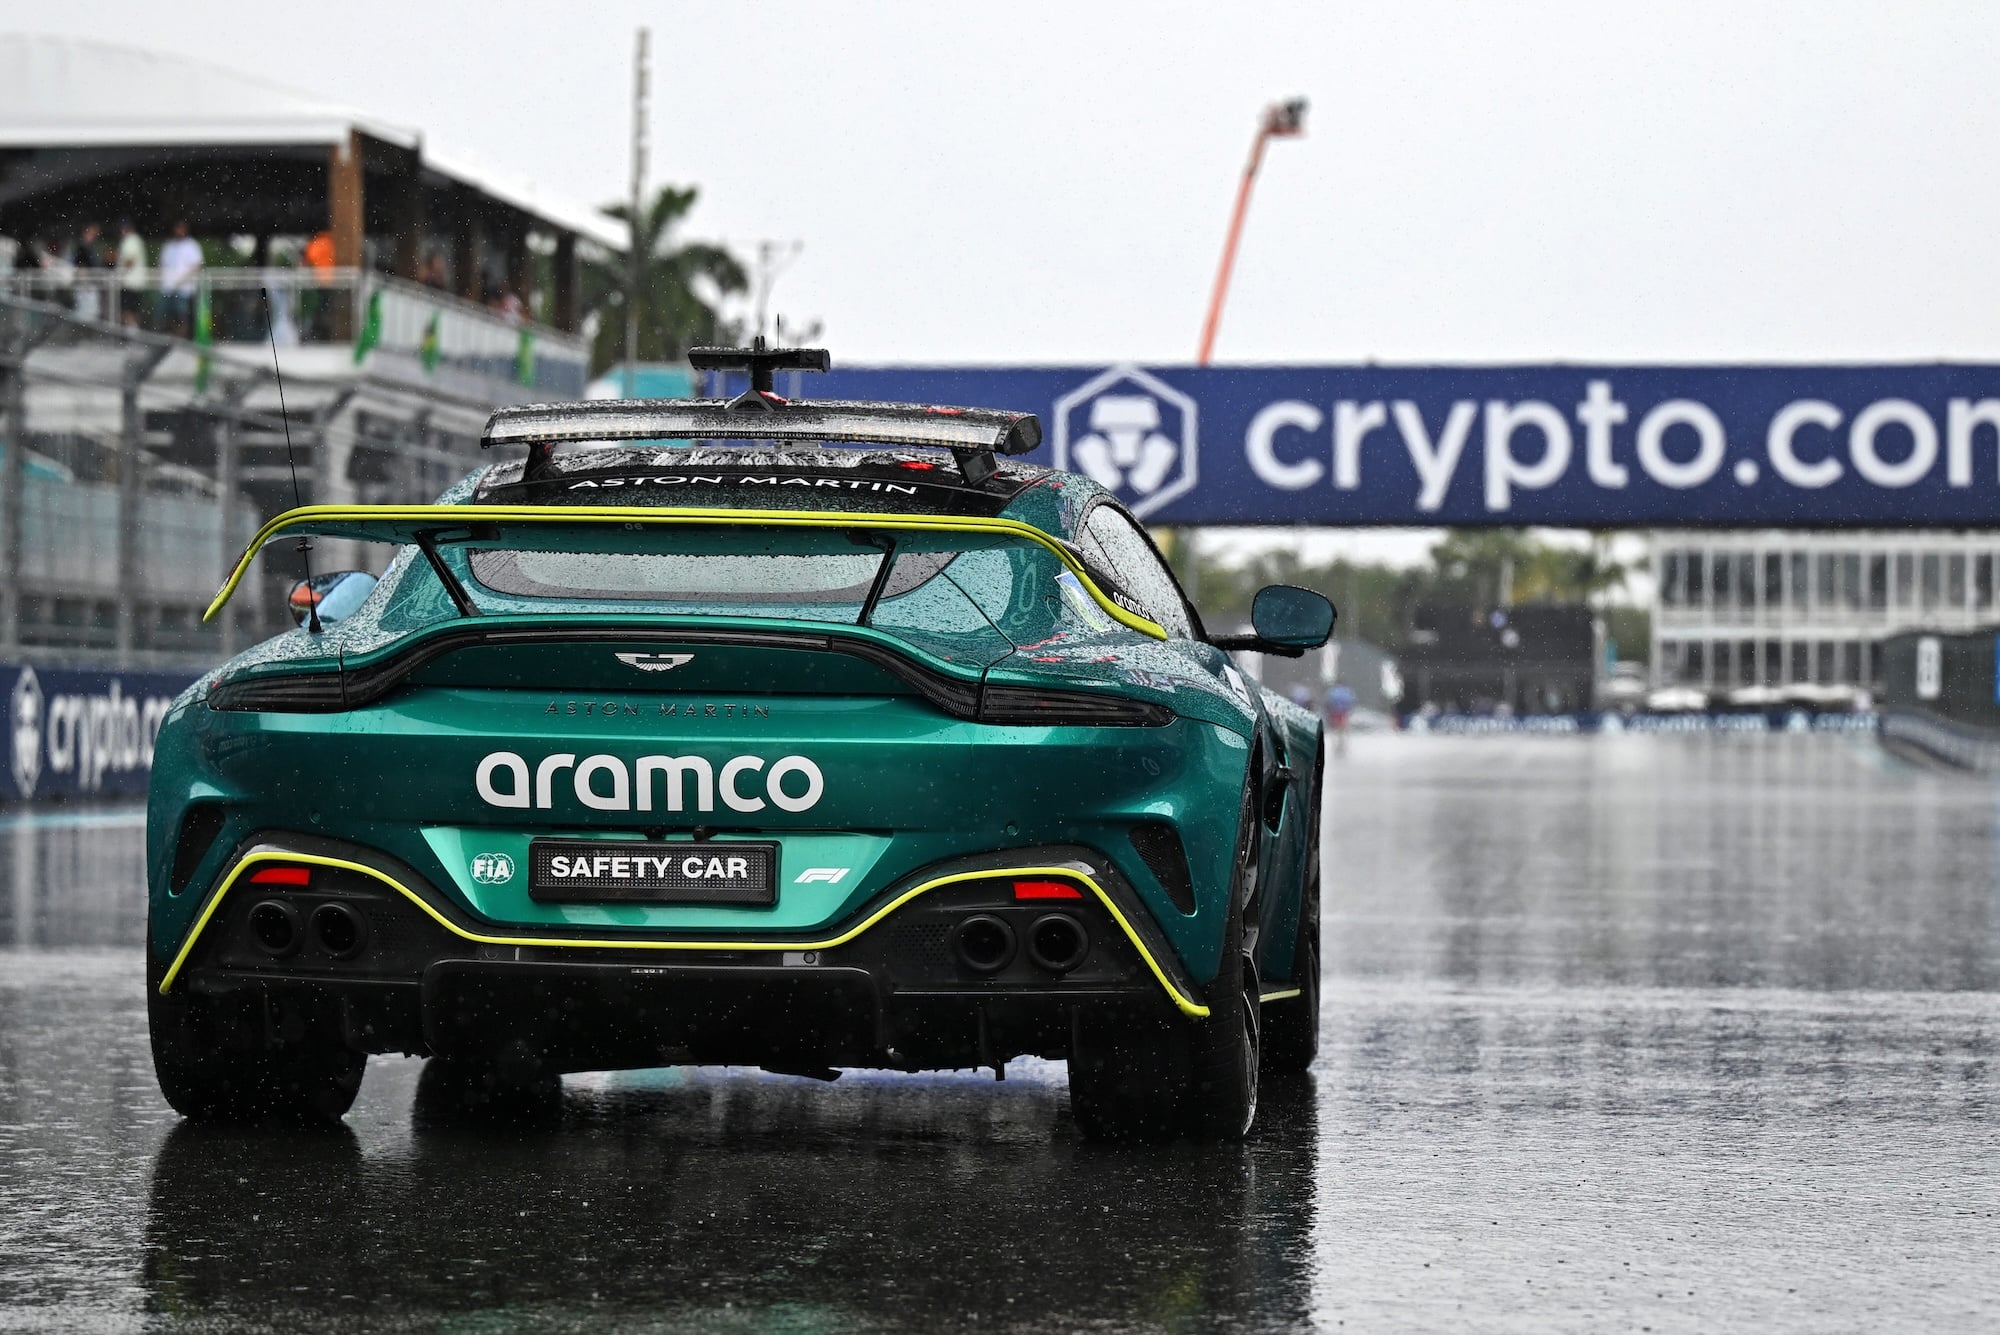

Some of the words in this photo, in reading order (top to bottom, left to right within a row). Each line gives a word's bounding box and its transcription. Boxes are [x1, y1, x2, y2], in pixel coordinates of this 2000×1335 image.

[568, 475, 722, 490] ASTON
[739, 475, 918, 495] MARTIN
[545, 700, 640, 717] ASTON
[658, 702, 770, 719] MARTIN
[475, 751, 825, 813] aramco
[550, 855, 672, 879] SAFETY
[681, 856, 748, 879] CAR
